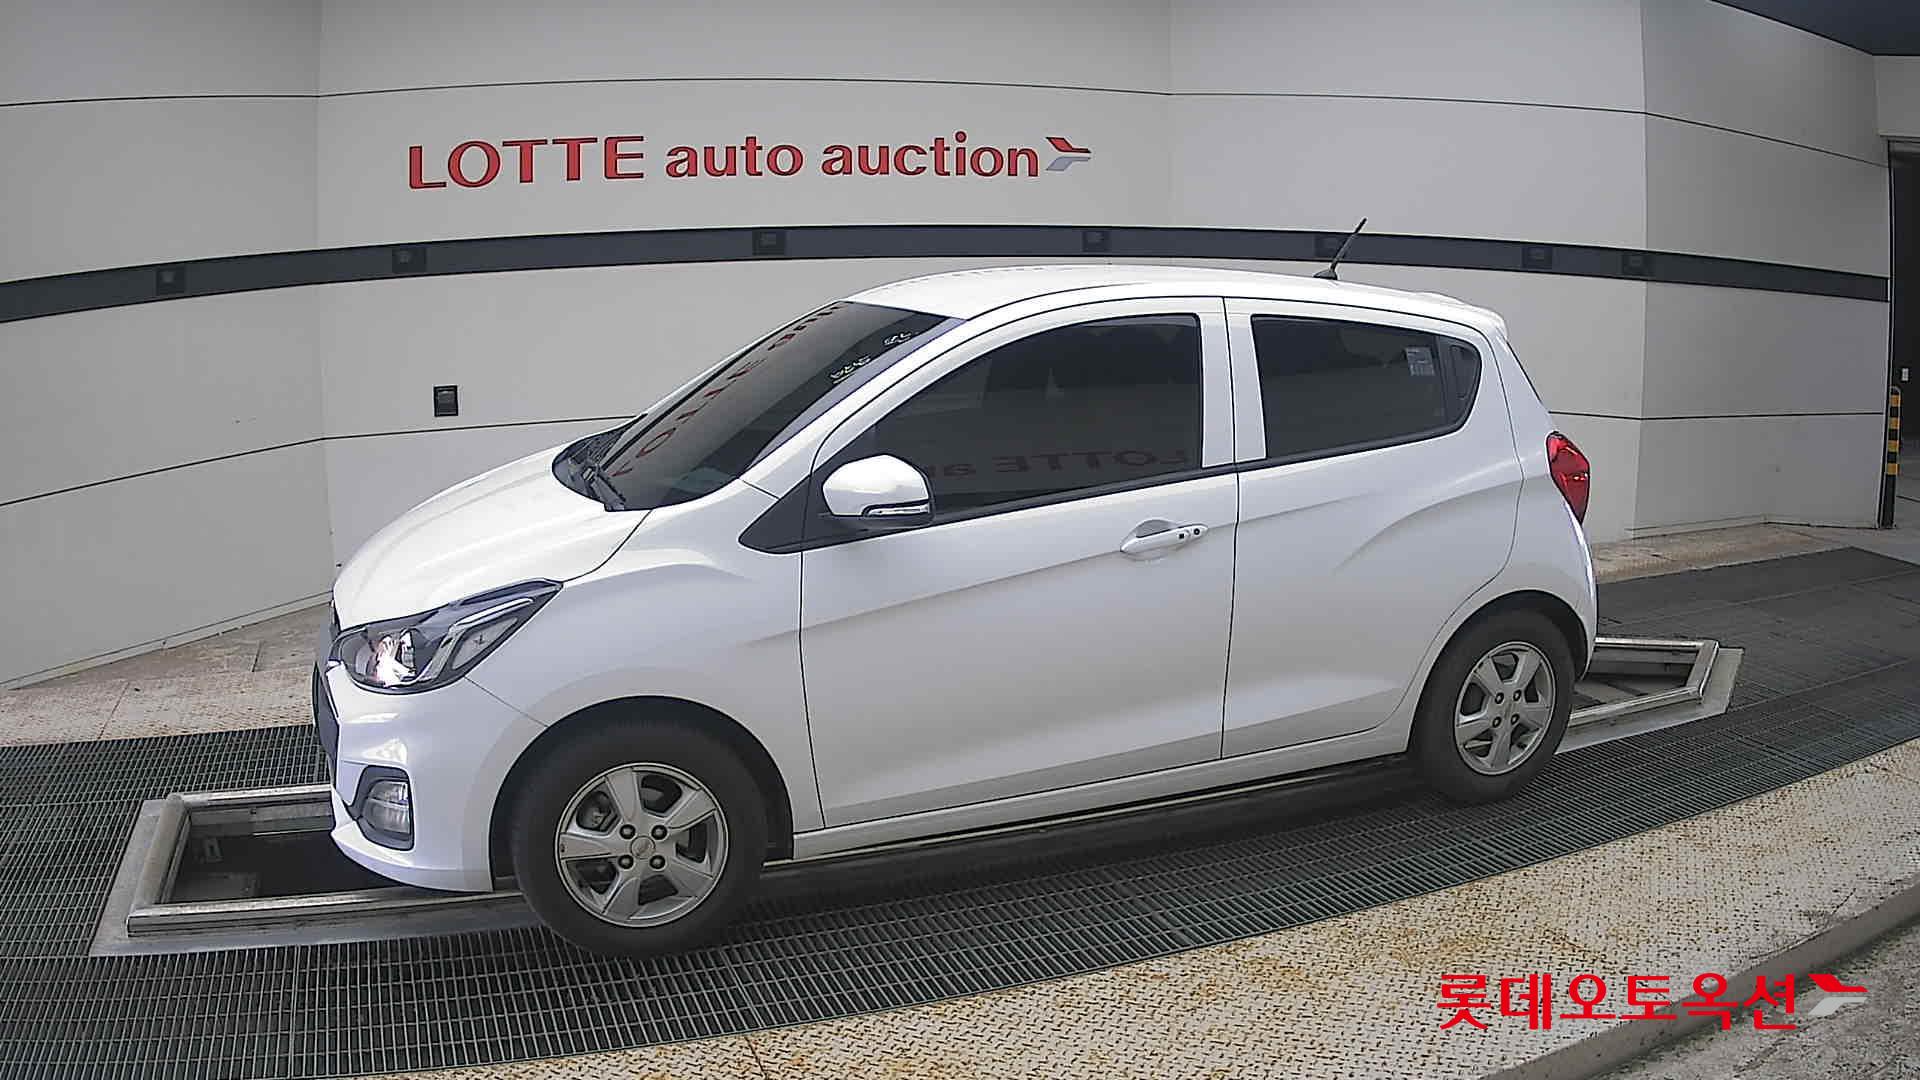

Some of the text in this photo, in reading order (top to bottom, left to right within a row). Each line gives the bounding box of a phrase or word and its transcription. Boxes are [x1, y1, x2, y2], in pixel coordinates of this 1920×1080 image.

[408, 131, 1040, 190] LOTTE auto auction
